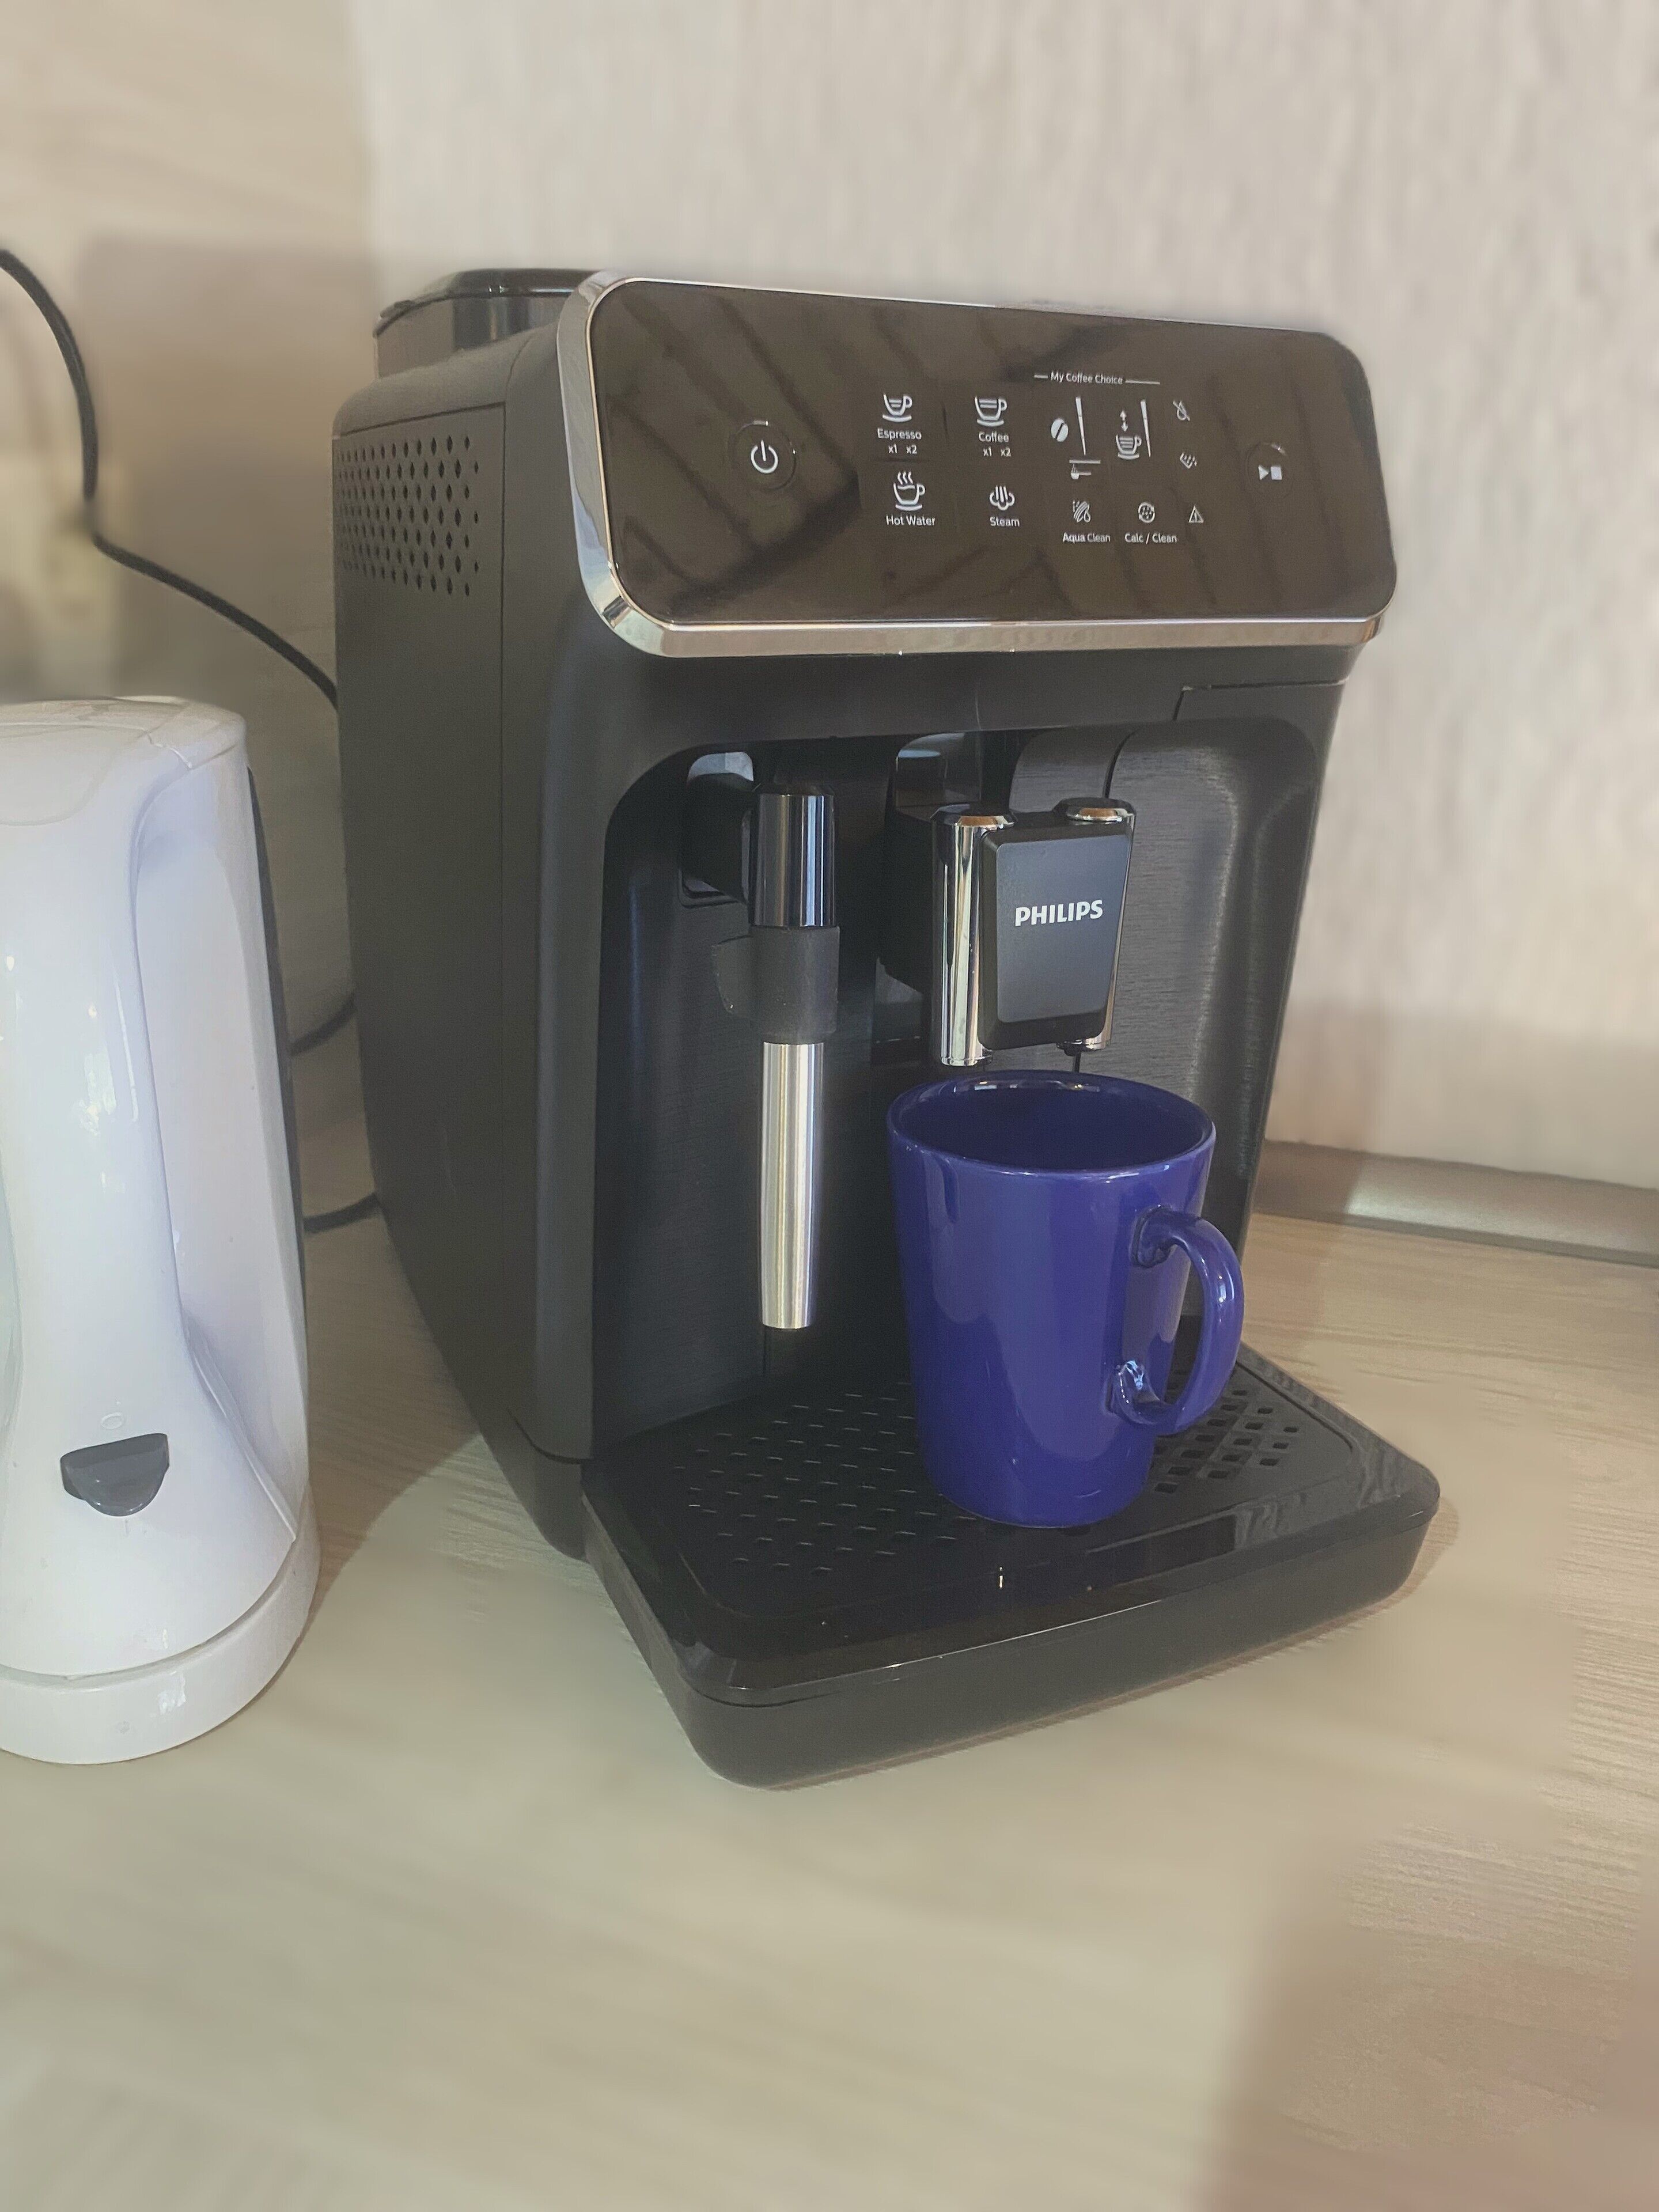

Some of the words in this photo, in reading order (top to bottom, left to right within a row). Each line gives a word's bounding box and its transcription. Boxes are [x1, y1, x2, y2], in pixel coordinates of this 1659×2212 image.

[1051, 372, 1064, 382] My
[1066, 372, 1093, 384] Coffee
[1094, 374, 1123, 384] Choice
[877, 428, 922, 441] Espresso
[978, 431, 1009, 443] Coffee
[888, 444, 897, 454] x1
[906, 445, 918, 454] x2
[983, 448, 992, 457] x1
[1001, 448, 1012, 457] x2
[886, 515, 904, 526] Hot
[906, 515, 935, 527] Water
[990, 516, 1020, 527] Steam
[1062, 532, 1086, 544] Aqua
[1087, 533, 1111, 543] Clean
[1124, 533, 1144, 543] Calc
[1152, 533, 1177, 543] Clean
[1015, 899, 1103, 926] PHILIPS
